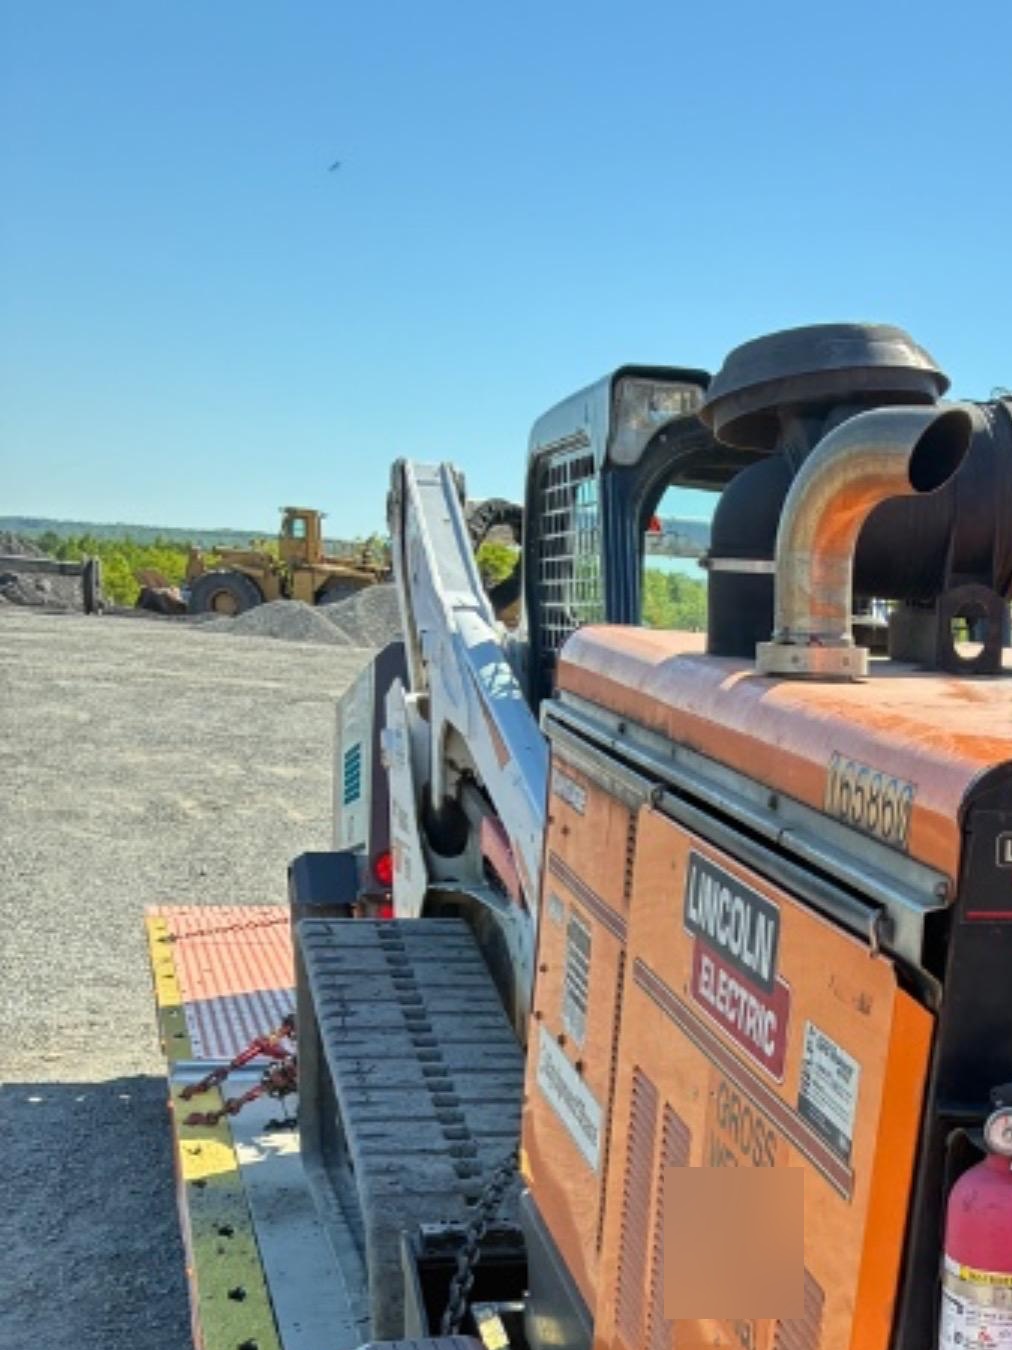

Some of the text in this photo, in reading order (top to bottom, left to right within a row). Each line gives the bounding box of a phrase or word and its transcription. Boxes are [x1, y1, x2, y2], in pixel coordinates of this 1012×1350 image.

[686, 864, 776, 981] LINCOLN
[698, 955, 778, 1058] ELECTRIC
[715, 1081, 779, 1168] GROSS
